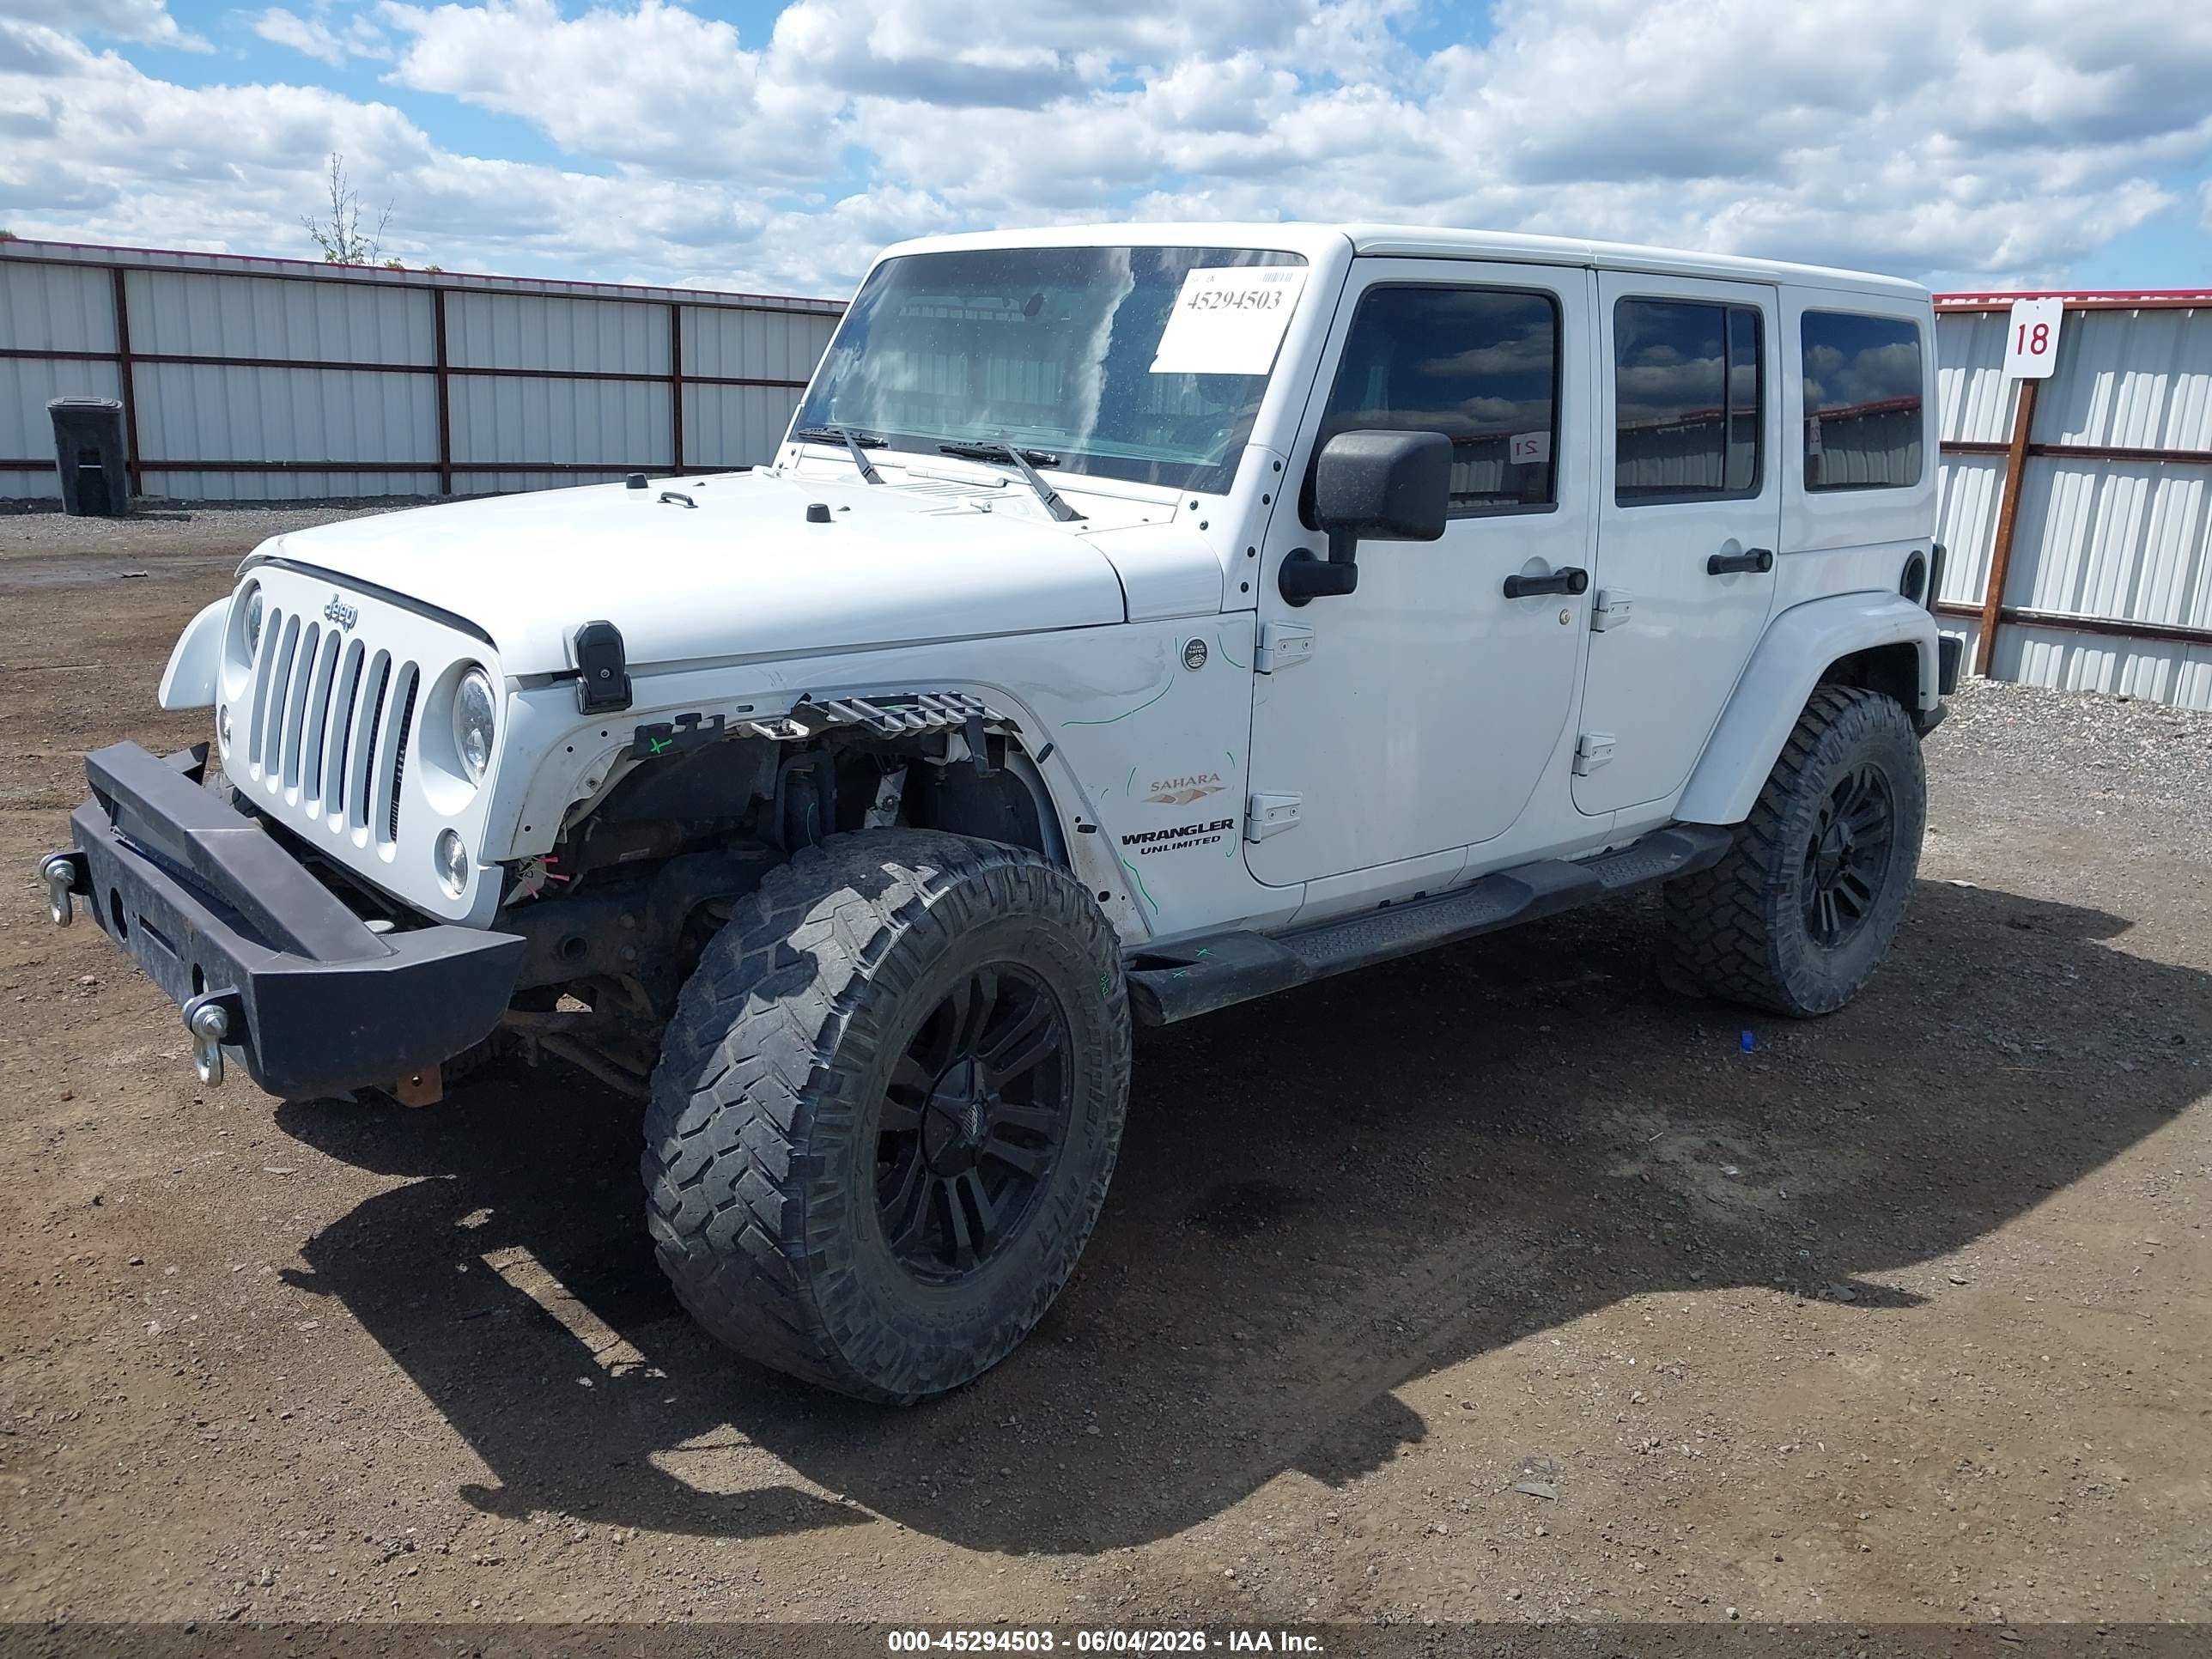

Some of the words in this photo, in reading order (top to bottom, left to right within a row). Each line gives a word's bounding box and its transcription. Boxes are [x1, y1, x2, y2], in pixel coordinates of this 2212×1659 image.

[1188, 290, 1282, 310] 45294503
[2017, 323, 2049, 356] 18
[324, 593, 358, 634] Jeep
[1151, 774, 1221, 793] SAHARA
[1121, 818, 1235, 846] WRANGLER
[1140, 836, 1221, 855] UNLIMITED
